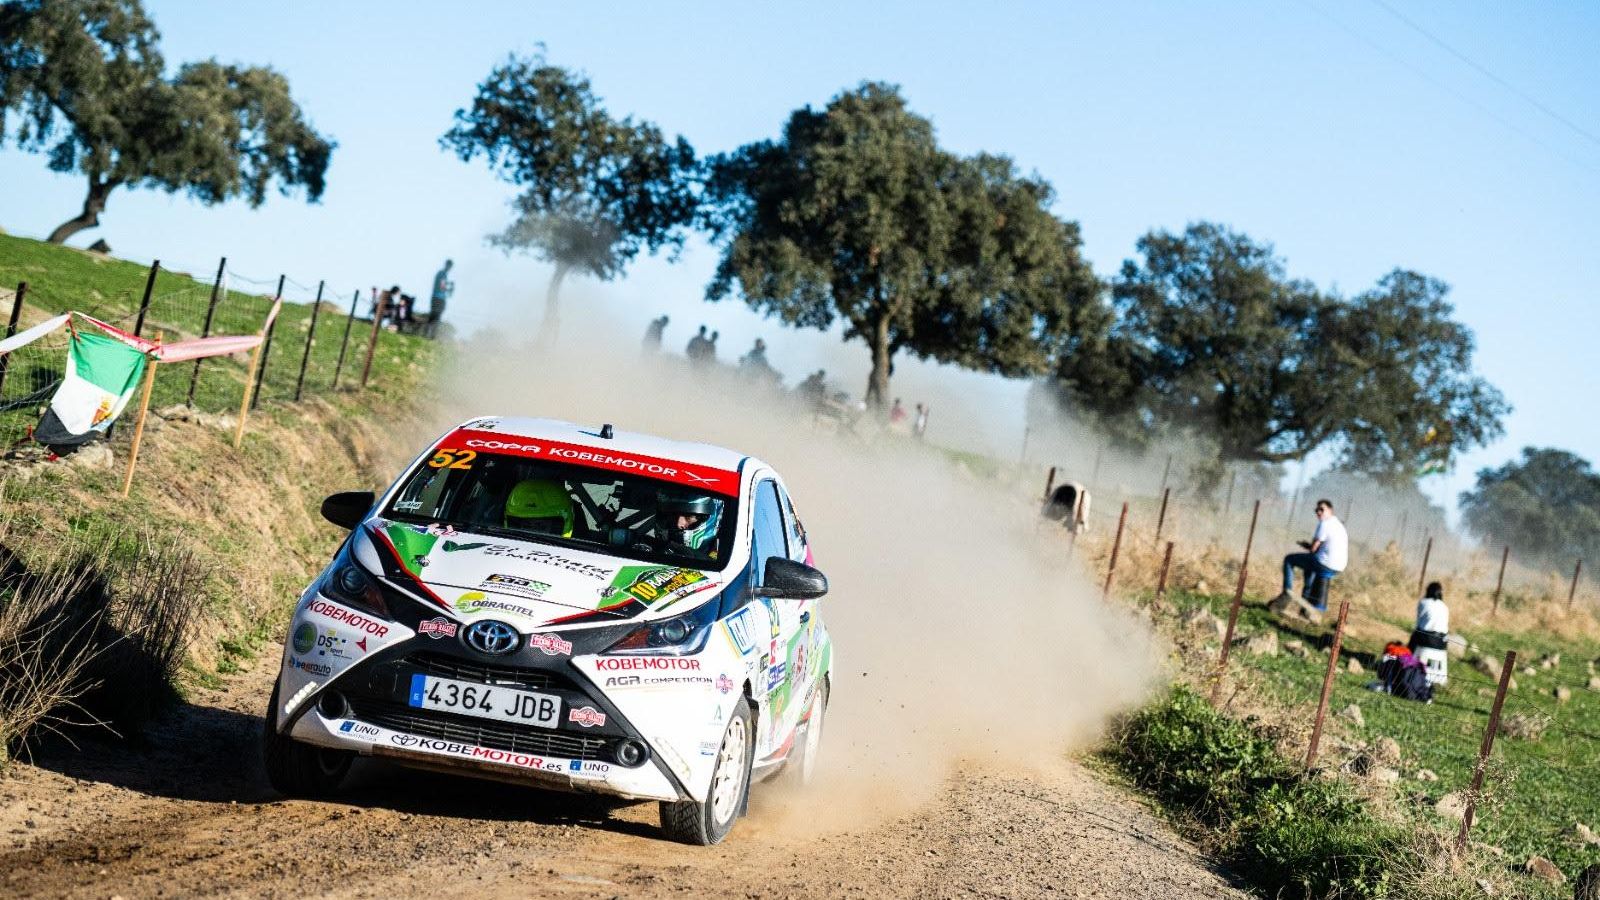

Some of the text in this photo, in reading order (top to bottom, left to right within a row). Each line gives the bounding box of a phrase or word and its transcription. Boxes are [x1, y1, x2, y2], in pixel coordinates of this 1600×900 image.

[428, 448, 477, 470] 52
[466, 439, 678, 477] COPA KOBEMOTOR
[630, 582, 658, 601] 10
[471, 600, 534, 618] OBRACITEL
[305, 600, 389, 638] KOBEMOTOR
[317, 635, 332, 648] DS
[596, 658, 700, 671] KOBEMOTOR
[605, 675, 641, 687] AGR
[427, 681, 493, 713] 4364
[504, 694, 554, 722] JDB
[354, 724, 380, 736] UNO
[419, 738, 562, 772] KOBEMOTOR.es
[583, 763, 609, 772] UNO
